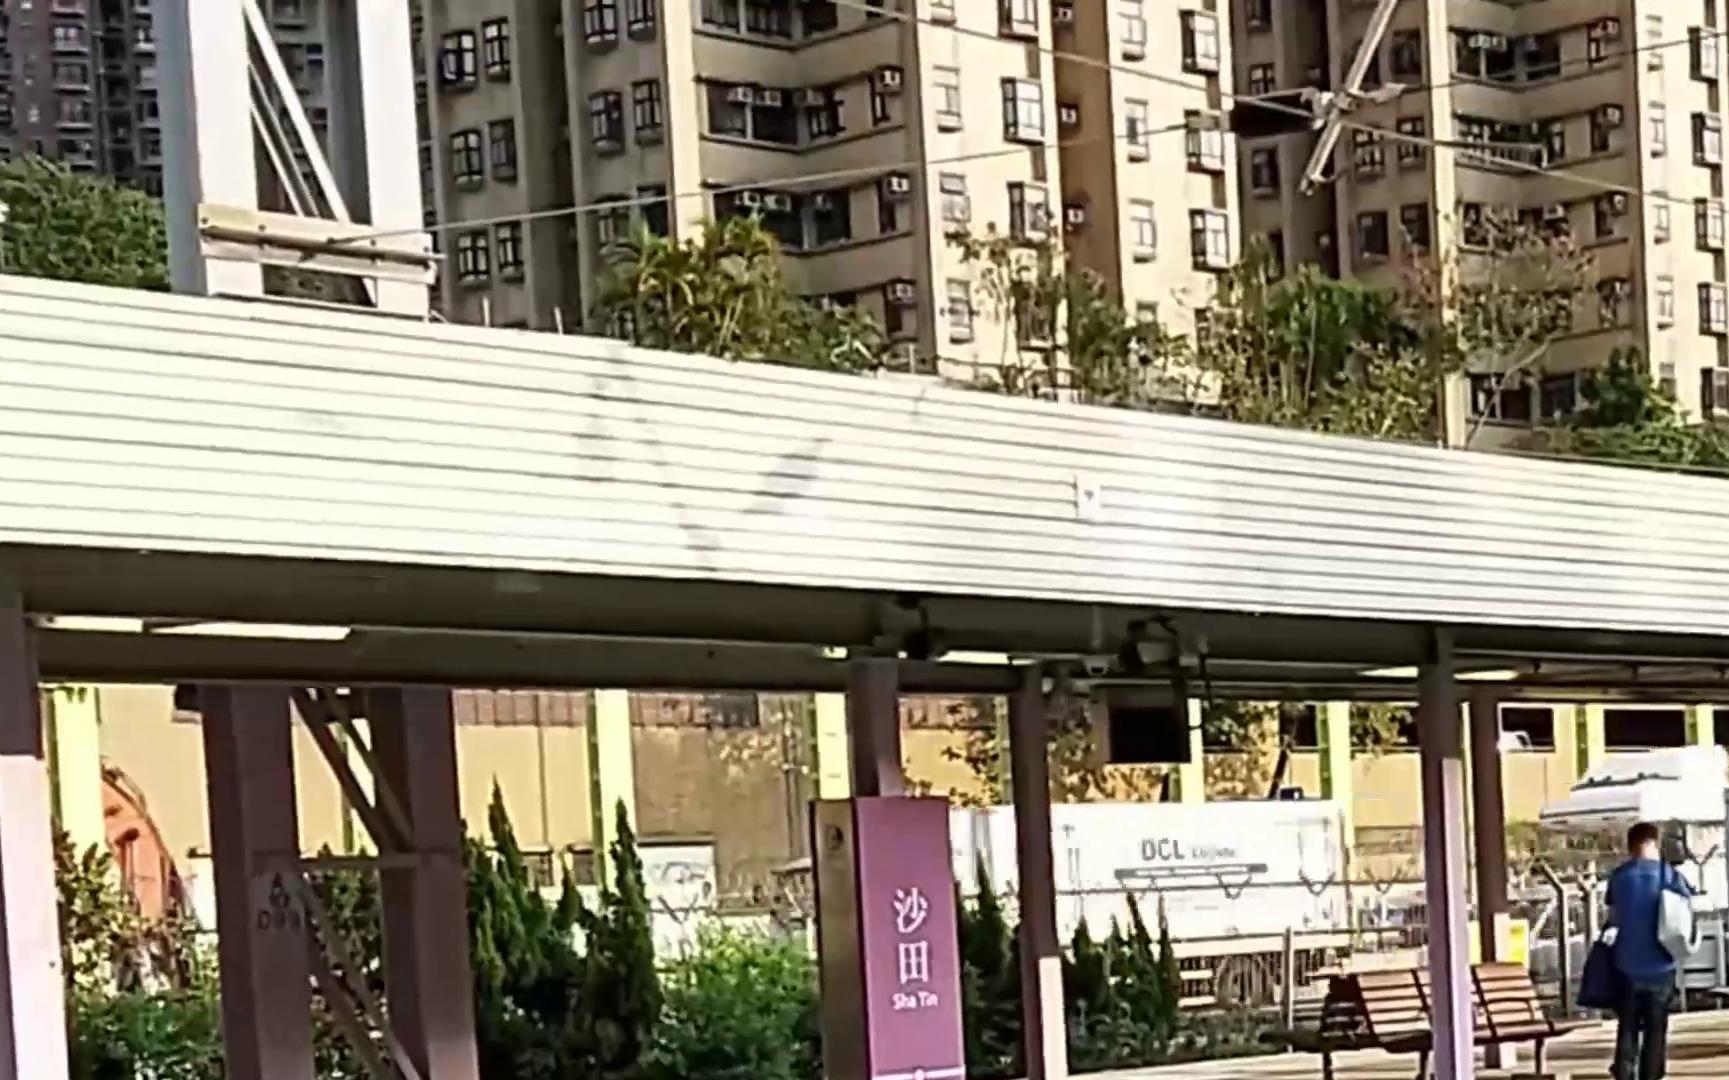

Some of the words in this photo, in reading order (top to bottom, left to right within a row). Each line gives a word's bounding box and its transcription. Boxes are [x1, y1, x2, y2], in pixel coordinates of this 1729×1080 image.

[1140, 837, 1185, 861] DCL
[892, 887, 929, 985] 沙田
[891, 992, 917, 1011] Sha
[917, 991, 939, 1008] Tin
